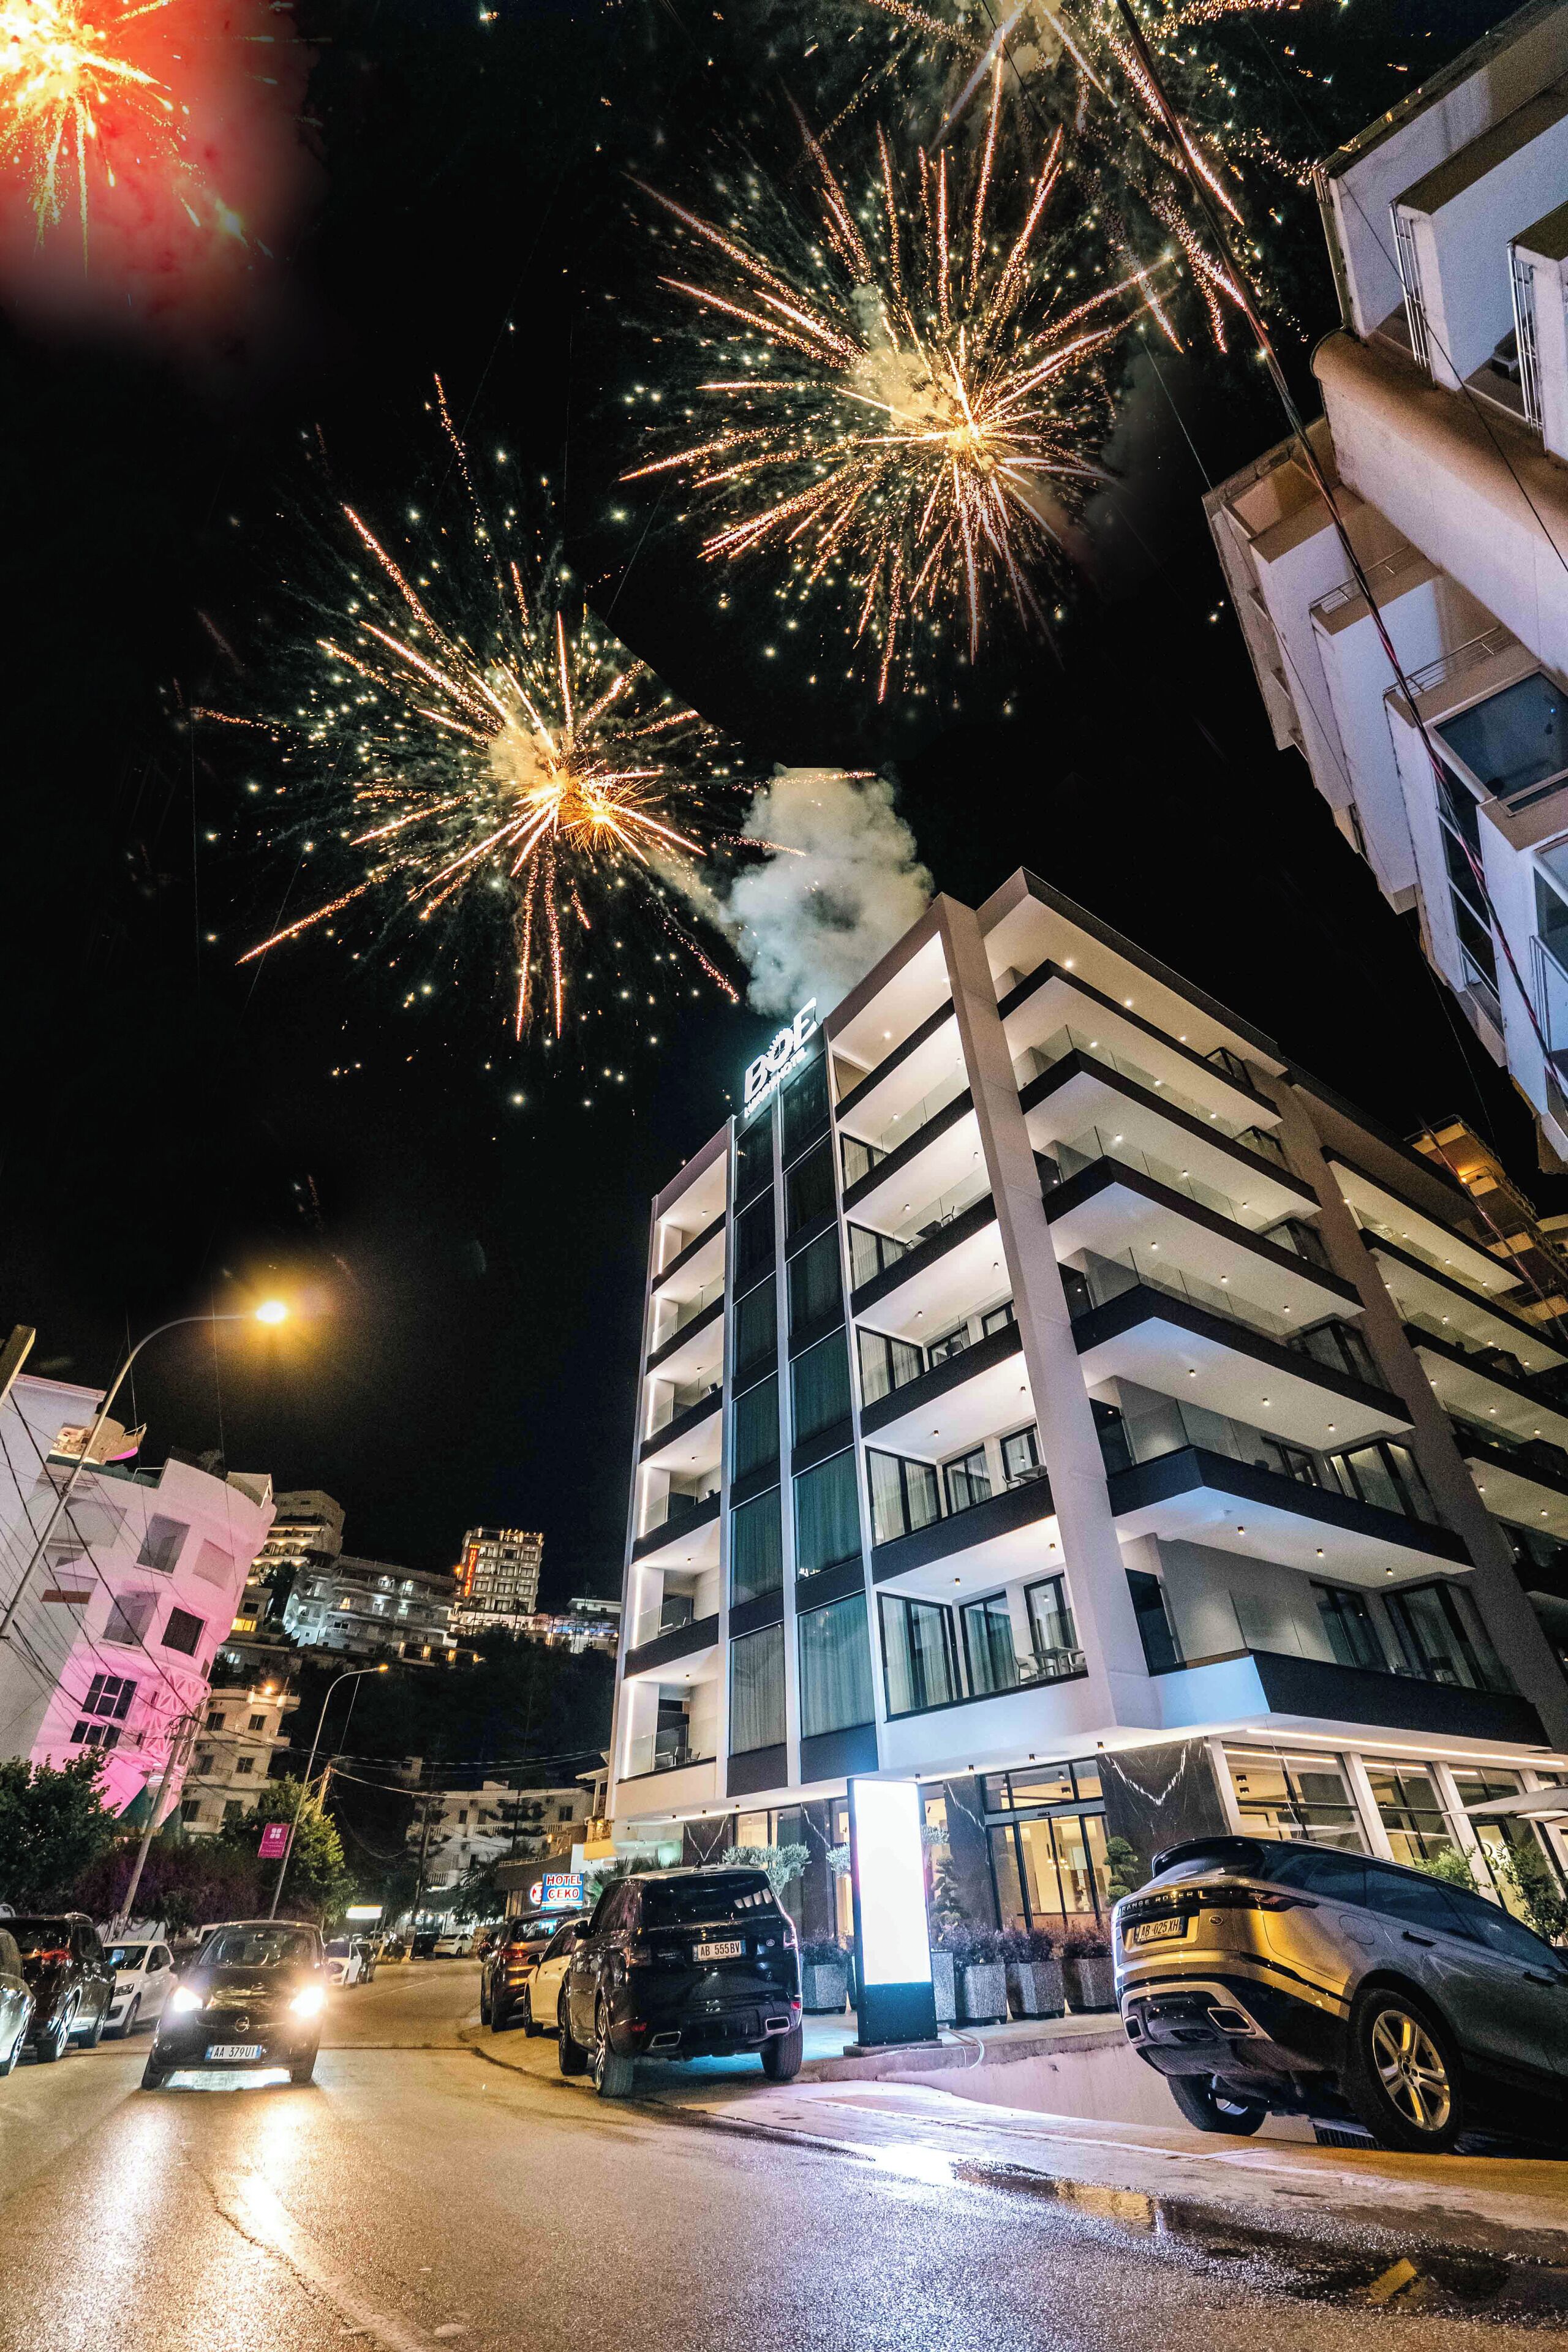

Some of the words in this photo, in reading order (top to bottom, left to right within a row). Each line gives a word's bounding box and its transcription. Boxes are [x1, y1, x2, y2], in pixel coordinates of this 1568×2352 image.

[467, 1549, 477, 1578] HOTEL
[546, 1875, 582, 1885] HOTEL
[1122, 1899, 1150, 1912] RANGE
[1155, 1891, 1193, 1902] ROVER
[1141, 1925, 1150, 1937] AB
[701, 1946, 710, 1956] AB
[714, 1942, 740, 1955] 555BV
[214, 2046, 225, 2057] AA
